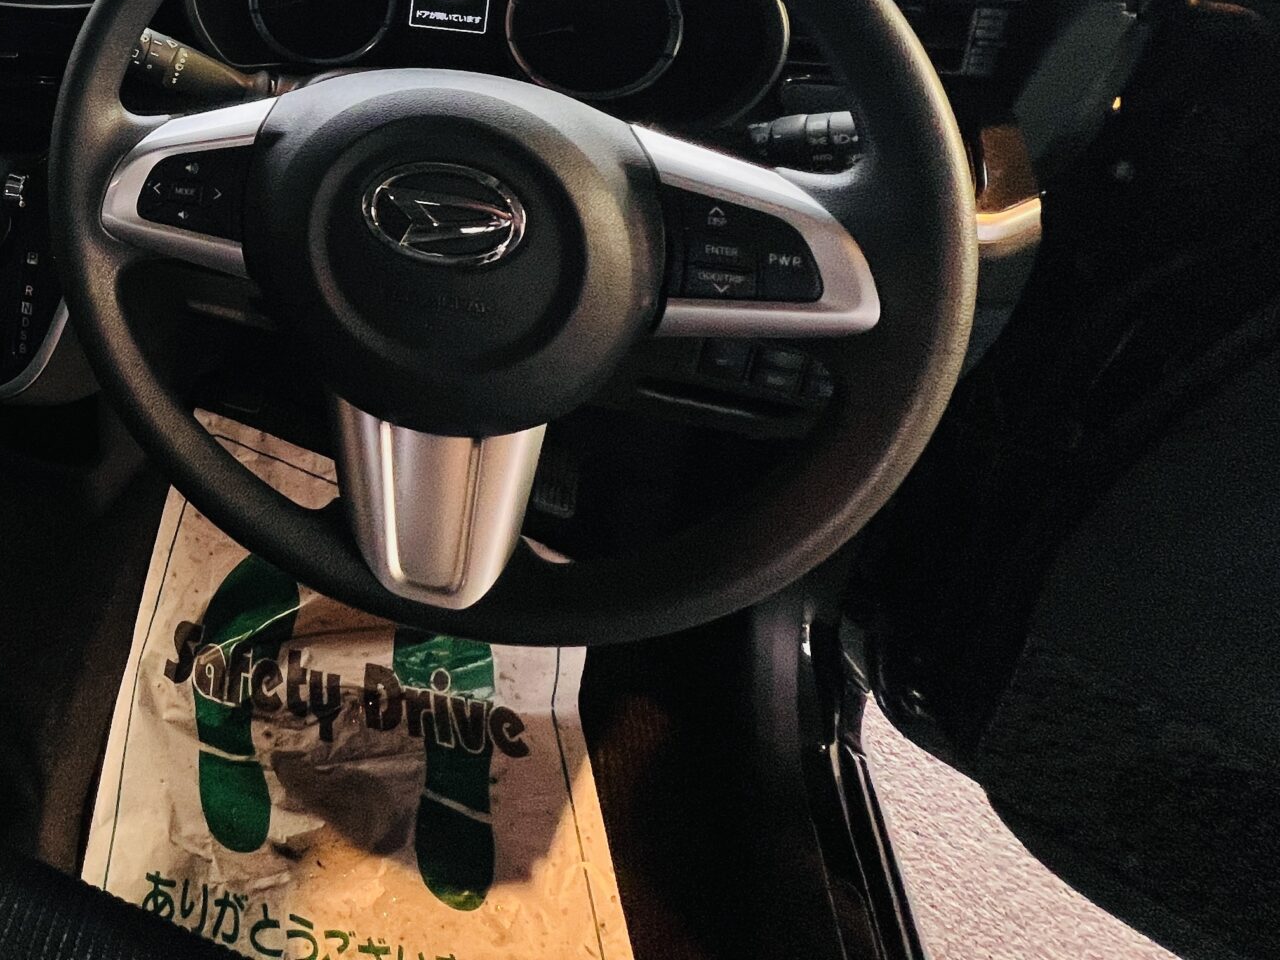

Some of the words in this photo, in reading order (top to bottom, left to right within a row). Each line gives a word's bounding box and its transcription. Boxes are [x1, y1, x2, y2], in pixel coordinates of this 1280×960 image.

[416, 10, 482, 24] ドアが開いています
[705, 244, 738, 256] ENTER
[27, 252, 39, 265] P
[769, 253, 802, 267] PWR
[25, 285, 34, 296] R
[21, 301, 33, 315] N
[164, 621, 341, 740] Safety
[364, 663, 530, 757] Drive
[142, 870, 456, 960] ありがとうござ
